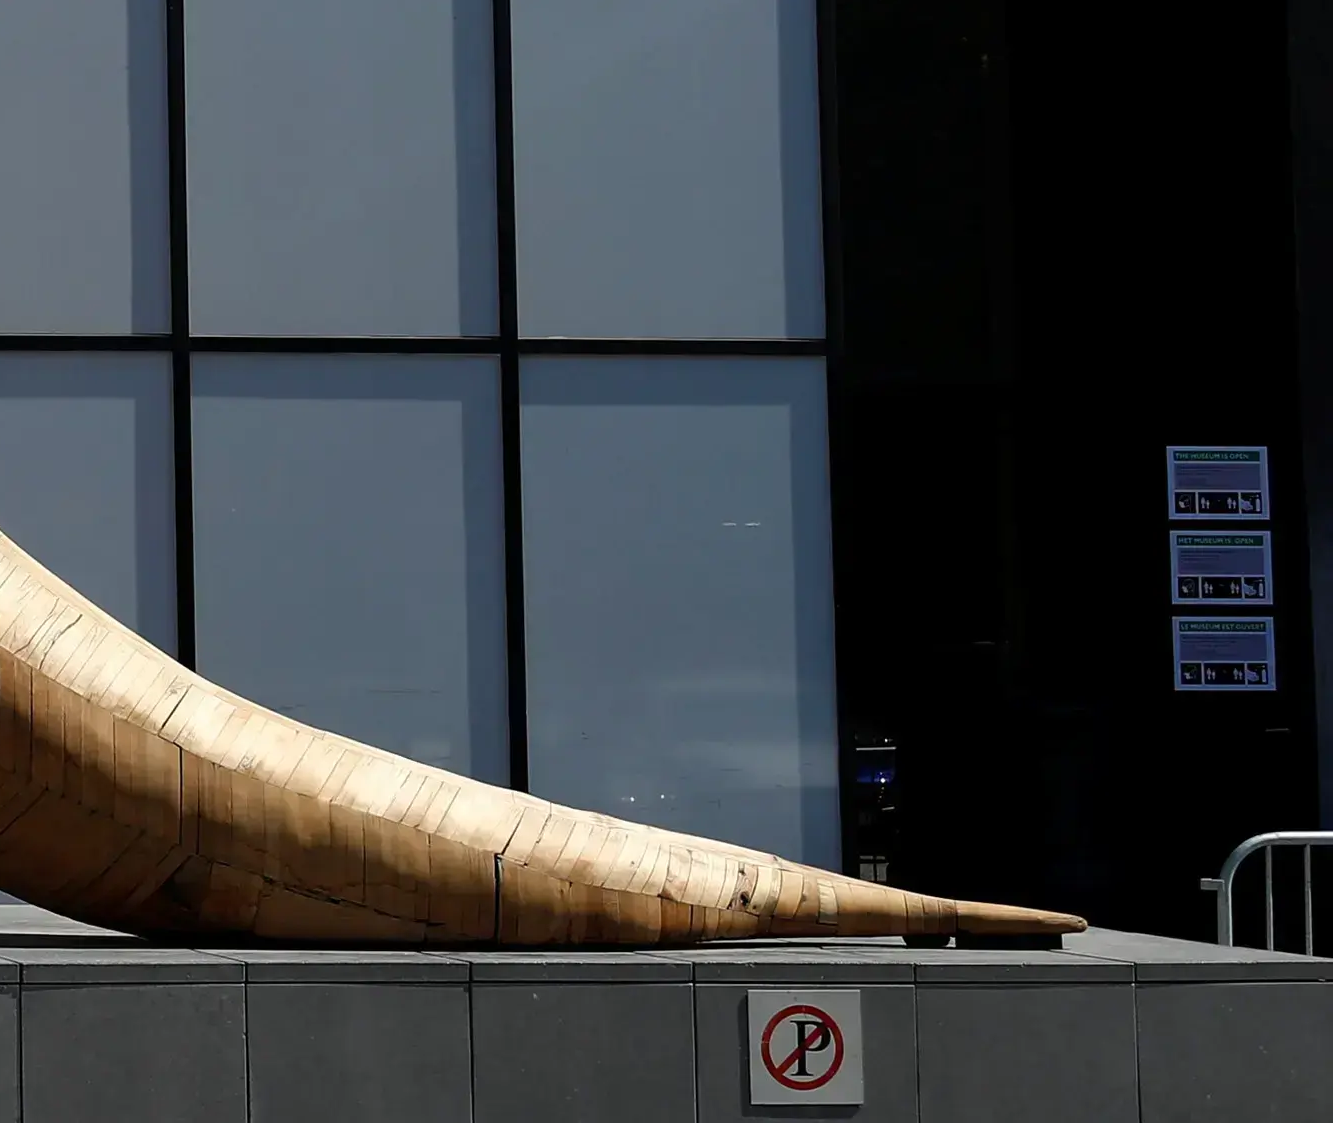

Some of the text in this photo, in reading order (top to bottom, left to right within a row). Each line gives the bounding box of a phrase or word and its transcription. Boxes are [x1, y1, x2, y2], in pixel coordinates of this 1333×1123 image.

[1190, 452, 1220, 461] MUSEUM
[1229, 452, 1249, 461] OPEN
[1194, 537, 1223, 545] MUSEUM
[1234, 537, 1254, 545] OPEN
[1190, 622, 1221, 631] MUSEUM
[1235, 622, 1264, 631] OUVERT
[790, 1020, 831, 1076] P
